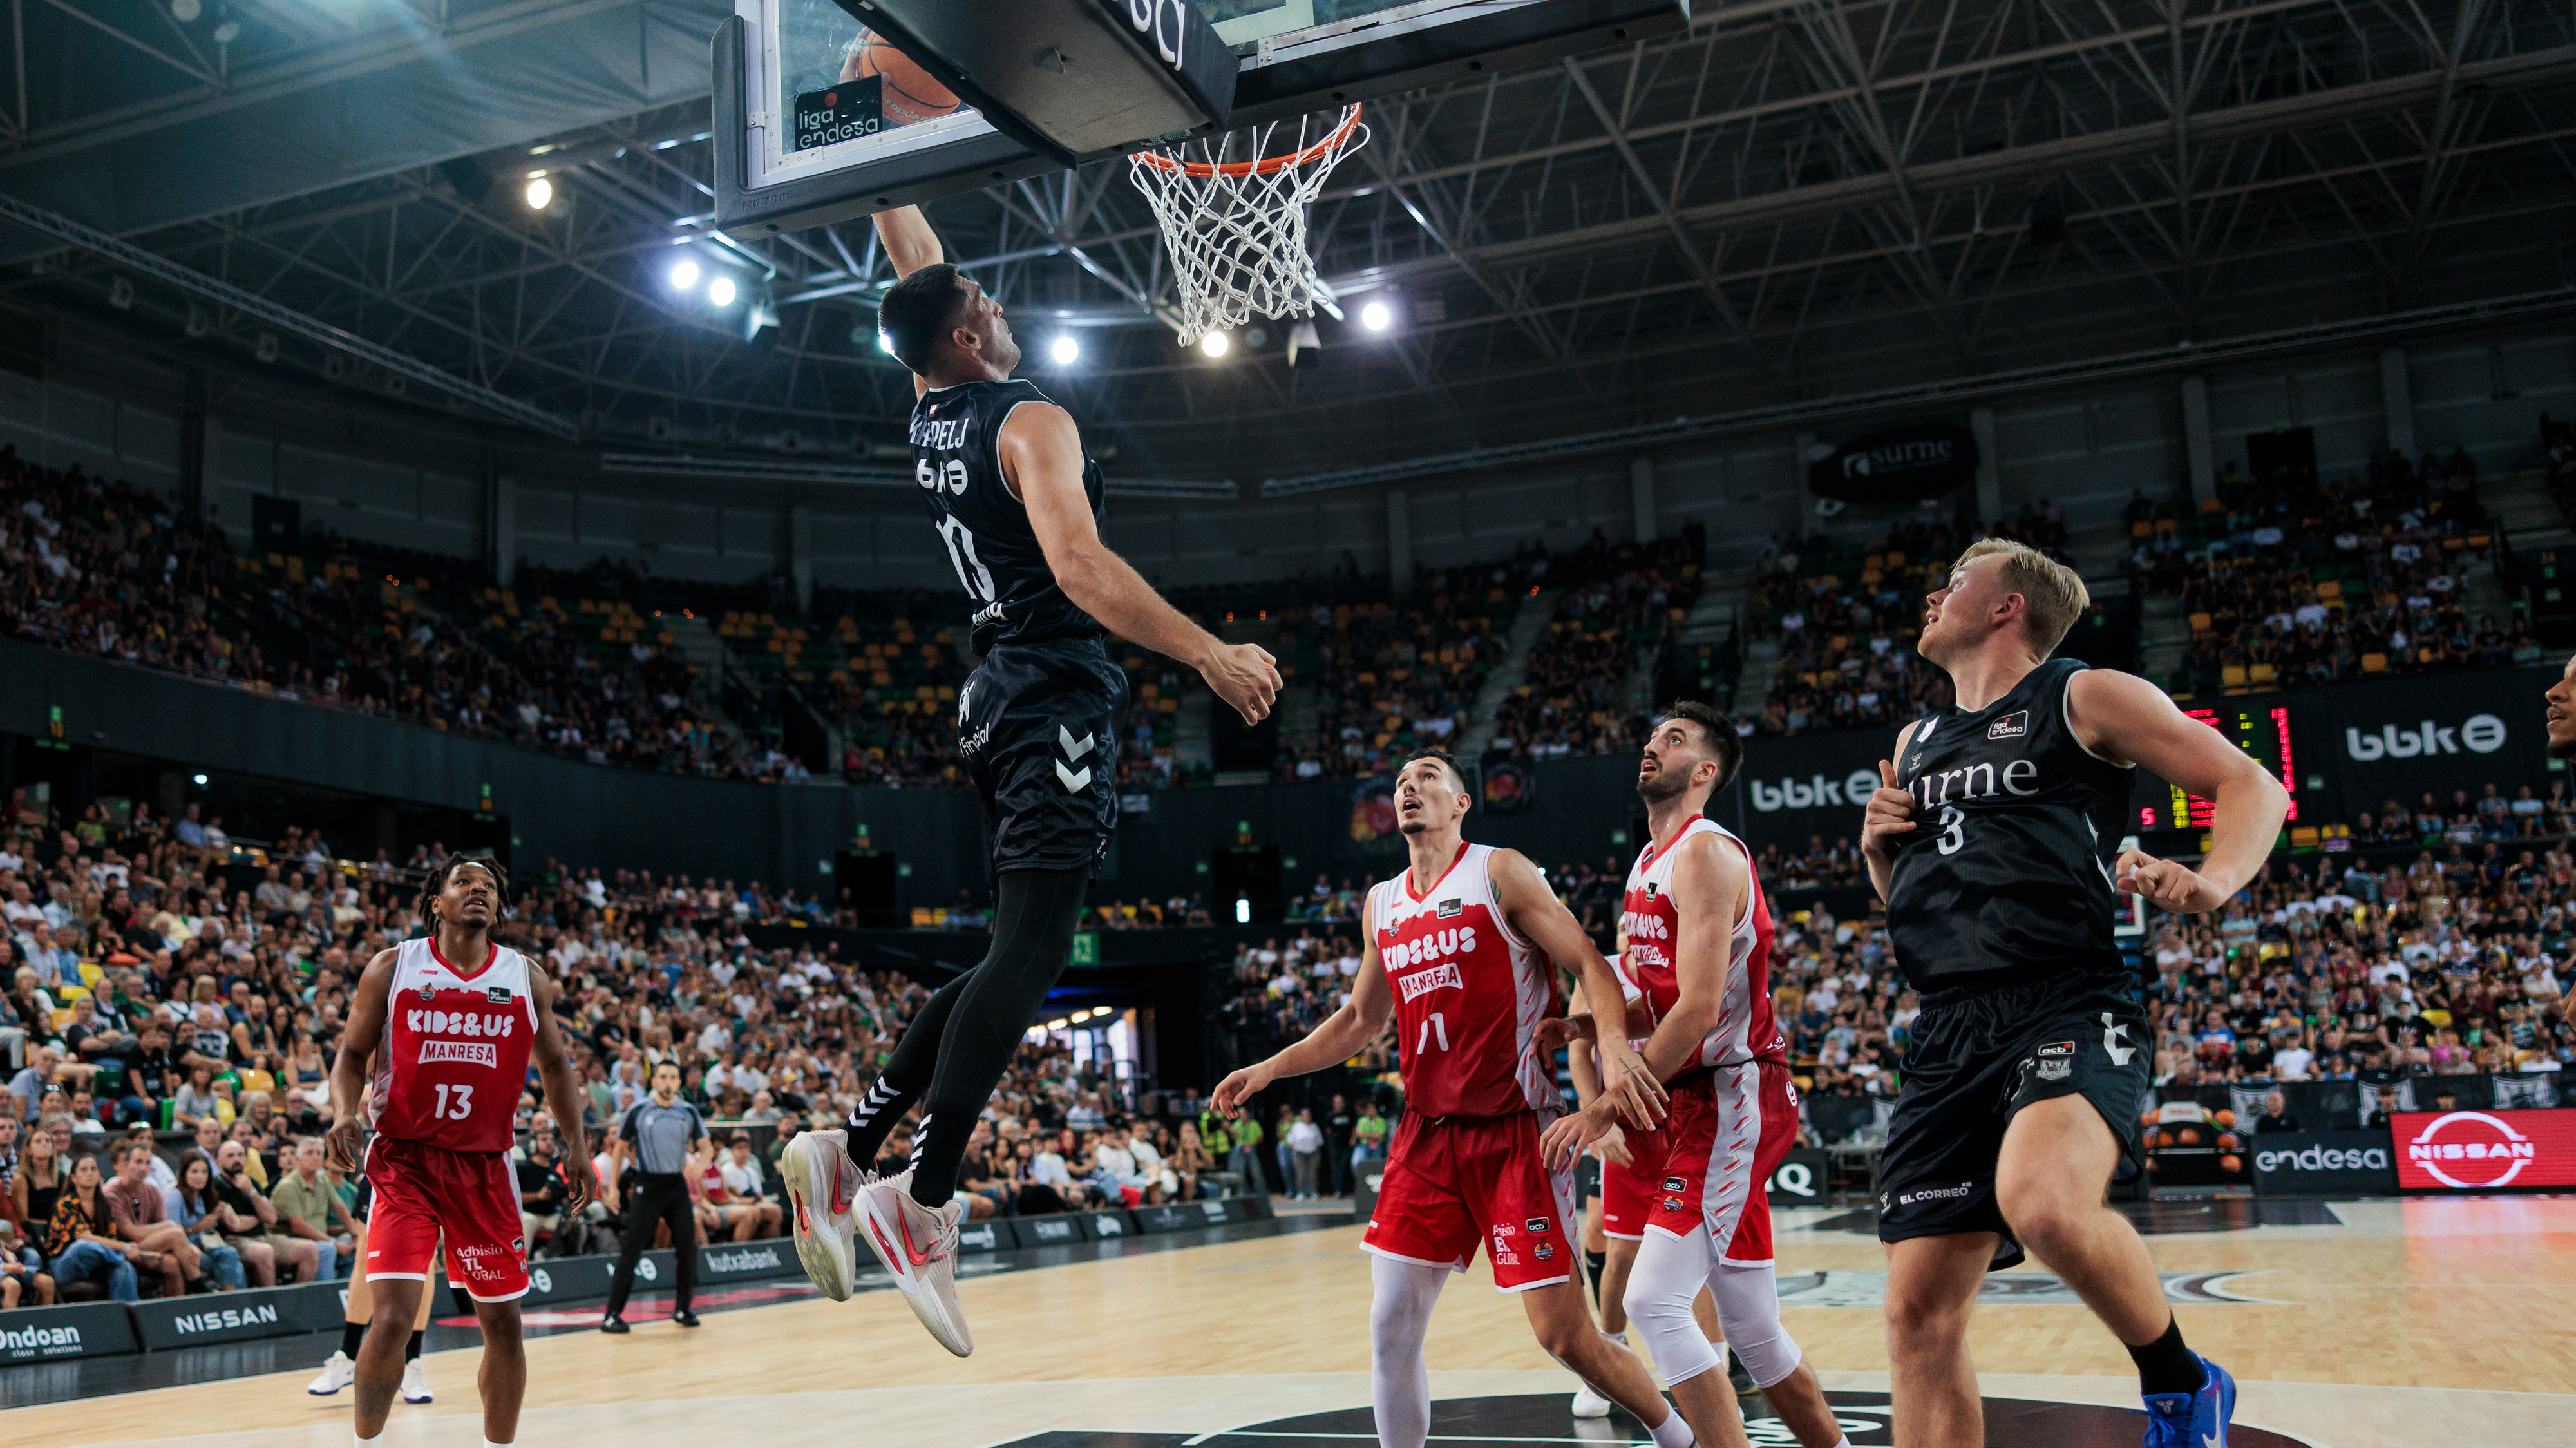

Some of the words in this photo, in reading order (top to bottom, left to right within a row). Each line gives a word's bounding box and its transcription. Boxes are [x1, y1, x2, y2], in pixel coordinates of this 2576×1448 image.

[799, 109, 834, 131] liga
[800, 115, 878, 149] endesa
[742, 194, 787, 211] MONDO
[1992, 726, 2023, 736] endesa
[2346, 719, 2459, 761] bbk
[1750, 774, 1844, 812] bbk
[1904, 759, 2039, 810] urne
[1937, 806, 1964, 855] 3
[1440, 908, 1460, 916] endesa
[1382, 926, 1476, 973] KIDS&US
[1401, 966, 1459, 998] MANRESA
[407, 1009, 515, 1038] KIDS&US
[424, 1043, 494, 1063] MANRESA
[435, 1083, 474, 1120] 13
[2255, 1144, 2387, 1172] endesa
[2409, 1141, 2535, 1160] NISSAN
[1900, 1194, 1915, 1205] EL
[1915, 1186, 1969, 1201] CORREO
[457, 1244, 503, 1258] Adbisio
[705, 1246, 781, 1273] kutxabank
[176, 1304, 278, 1335] NISSAN
